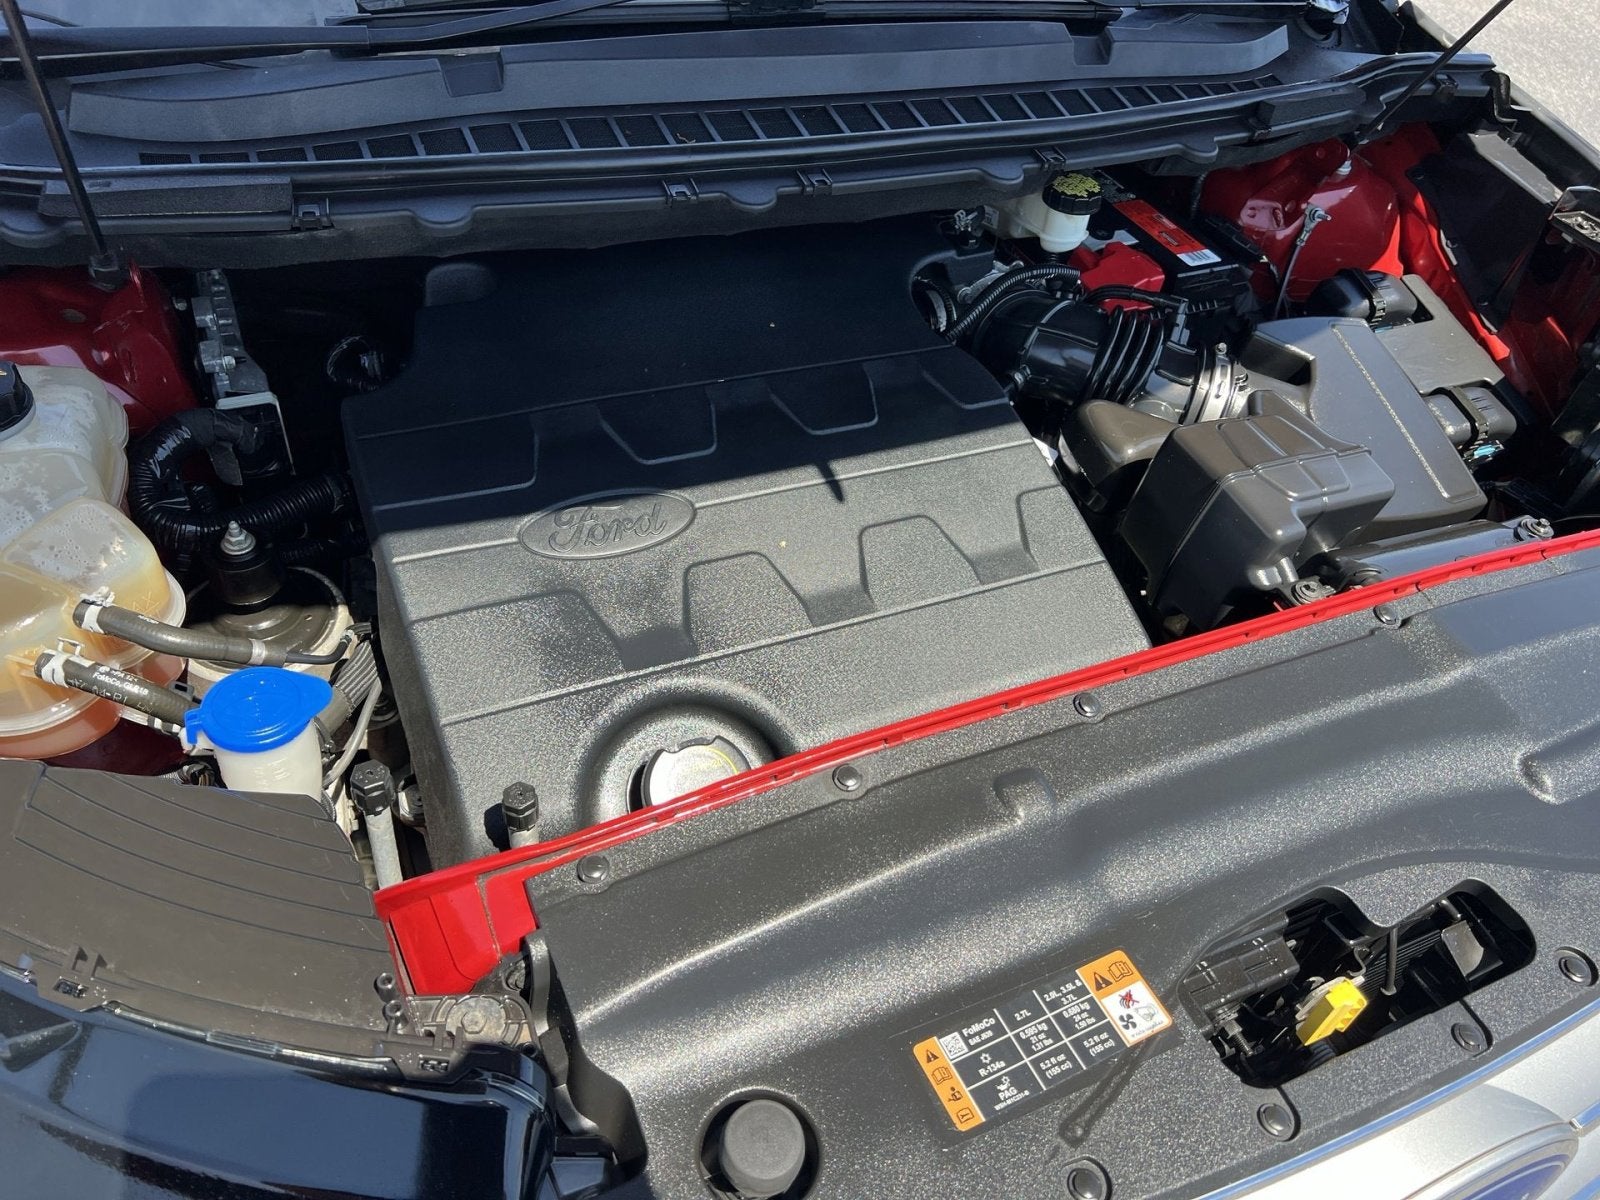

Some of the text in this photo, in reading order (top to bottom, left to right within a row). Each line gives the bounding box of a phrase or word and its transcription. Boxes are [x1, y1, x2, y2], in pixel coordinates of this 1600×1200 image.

[548, 502, 667, 553] Ford
[1060, 982, 1076, 994] 3.5L
[1061, 993, 1078, 1005] 3.7L
[1079, 1002, 1091, 1011] kg
[1014, 1009, 1032, 1021] 2.7L
[1080, 1011, 1089, 1019] oz
[1085, 1017, 1096, 1025] lbs
[961, 1017, 996, 1037] FoMoCo
[1036, 1022, 1048, 1031] kg
[1083, 1038, 1095, 1048] 5.2
[1089, 1038, 1115, 1057] (155 cc)
[1040, 1060, 1052, 1070] 5.2
[1056, 1053, 1066, 1061] oz
[978, 1061, 1006, 1078] R-134a
[1045, 1060, 1073, 1079] (155 cc)
[998, 1086, 1018, 1101] PAG
